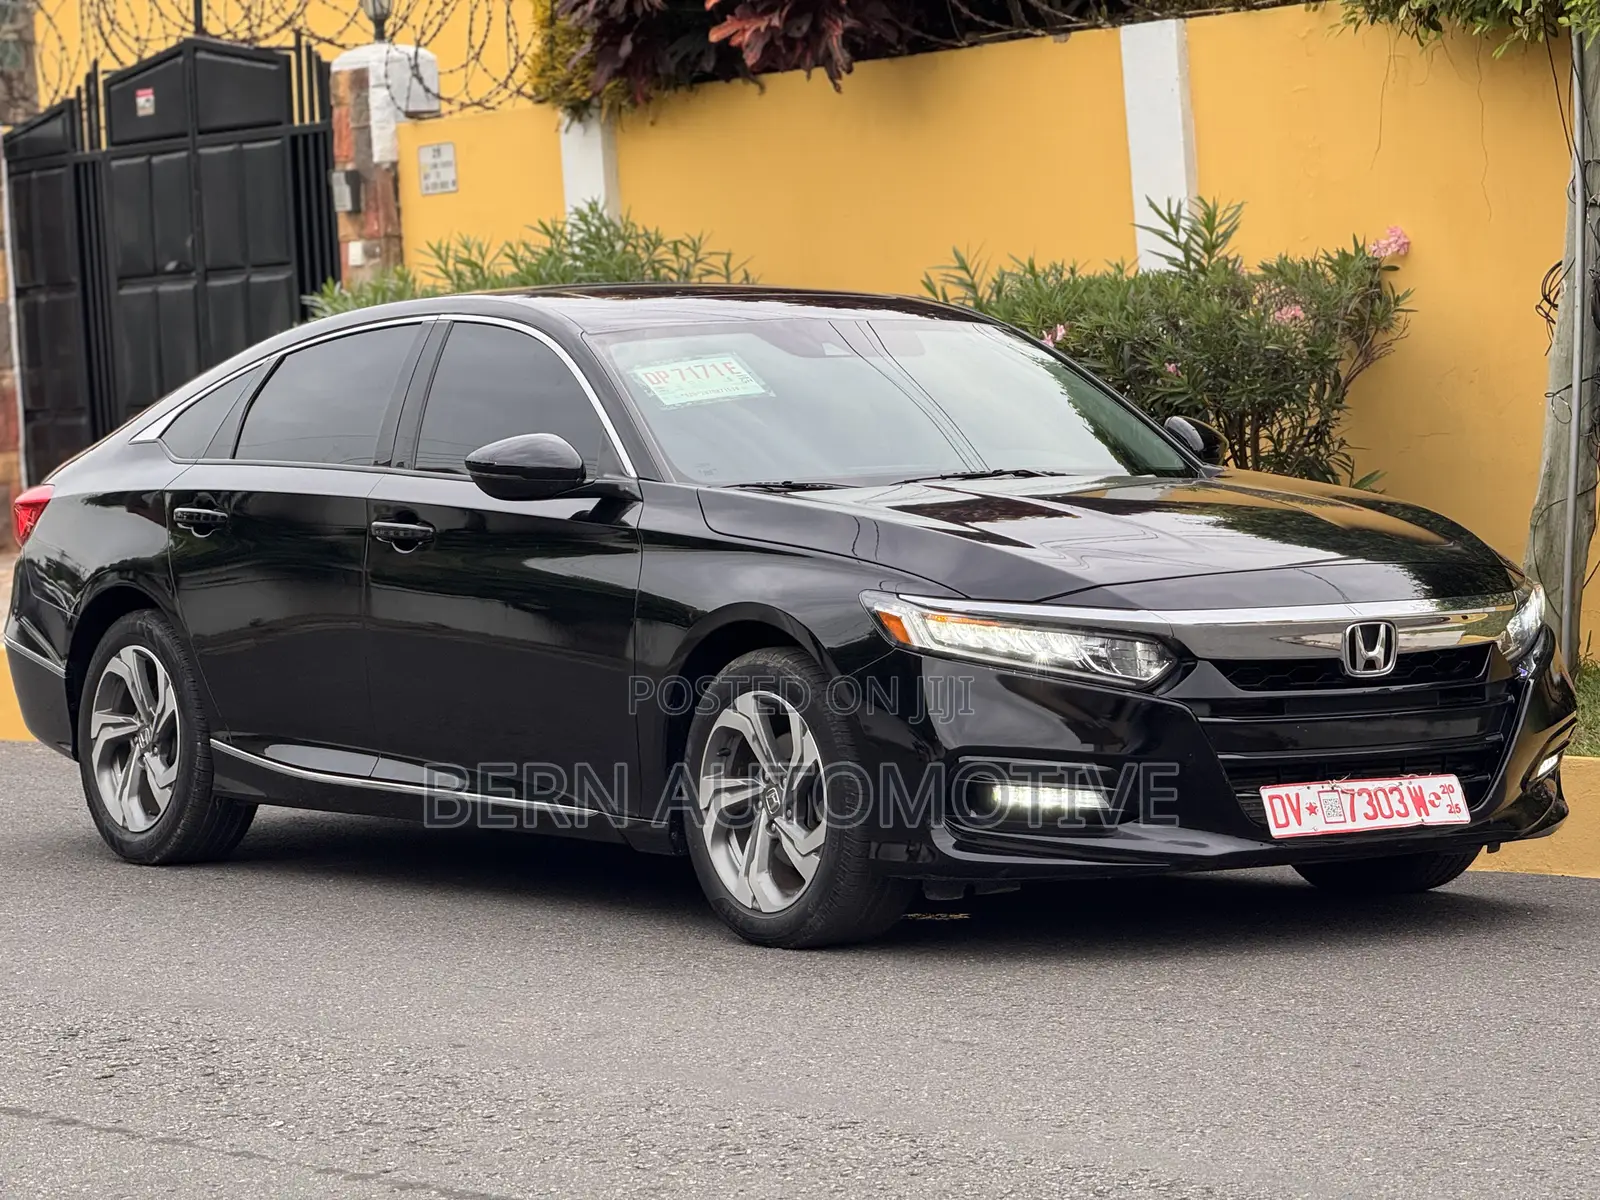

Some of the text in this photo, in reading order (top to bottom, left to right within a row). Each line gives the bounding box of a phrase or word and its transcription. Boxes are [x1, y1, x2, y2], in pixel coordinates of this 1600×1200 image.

[642, 370, 670, 386] DP
[671, 362, 724, 382] 7171
[1267, 792, 1302, 829] DV
